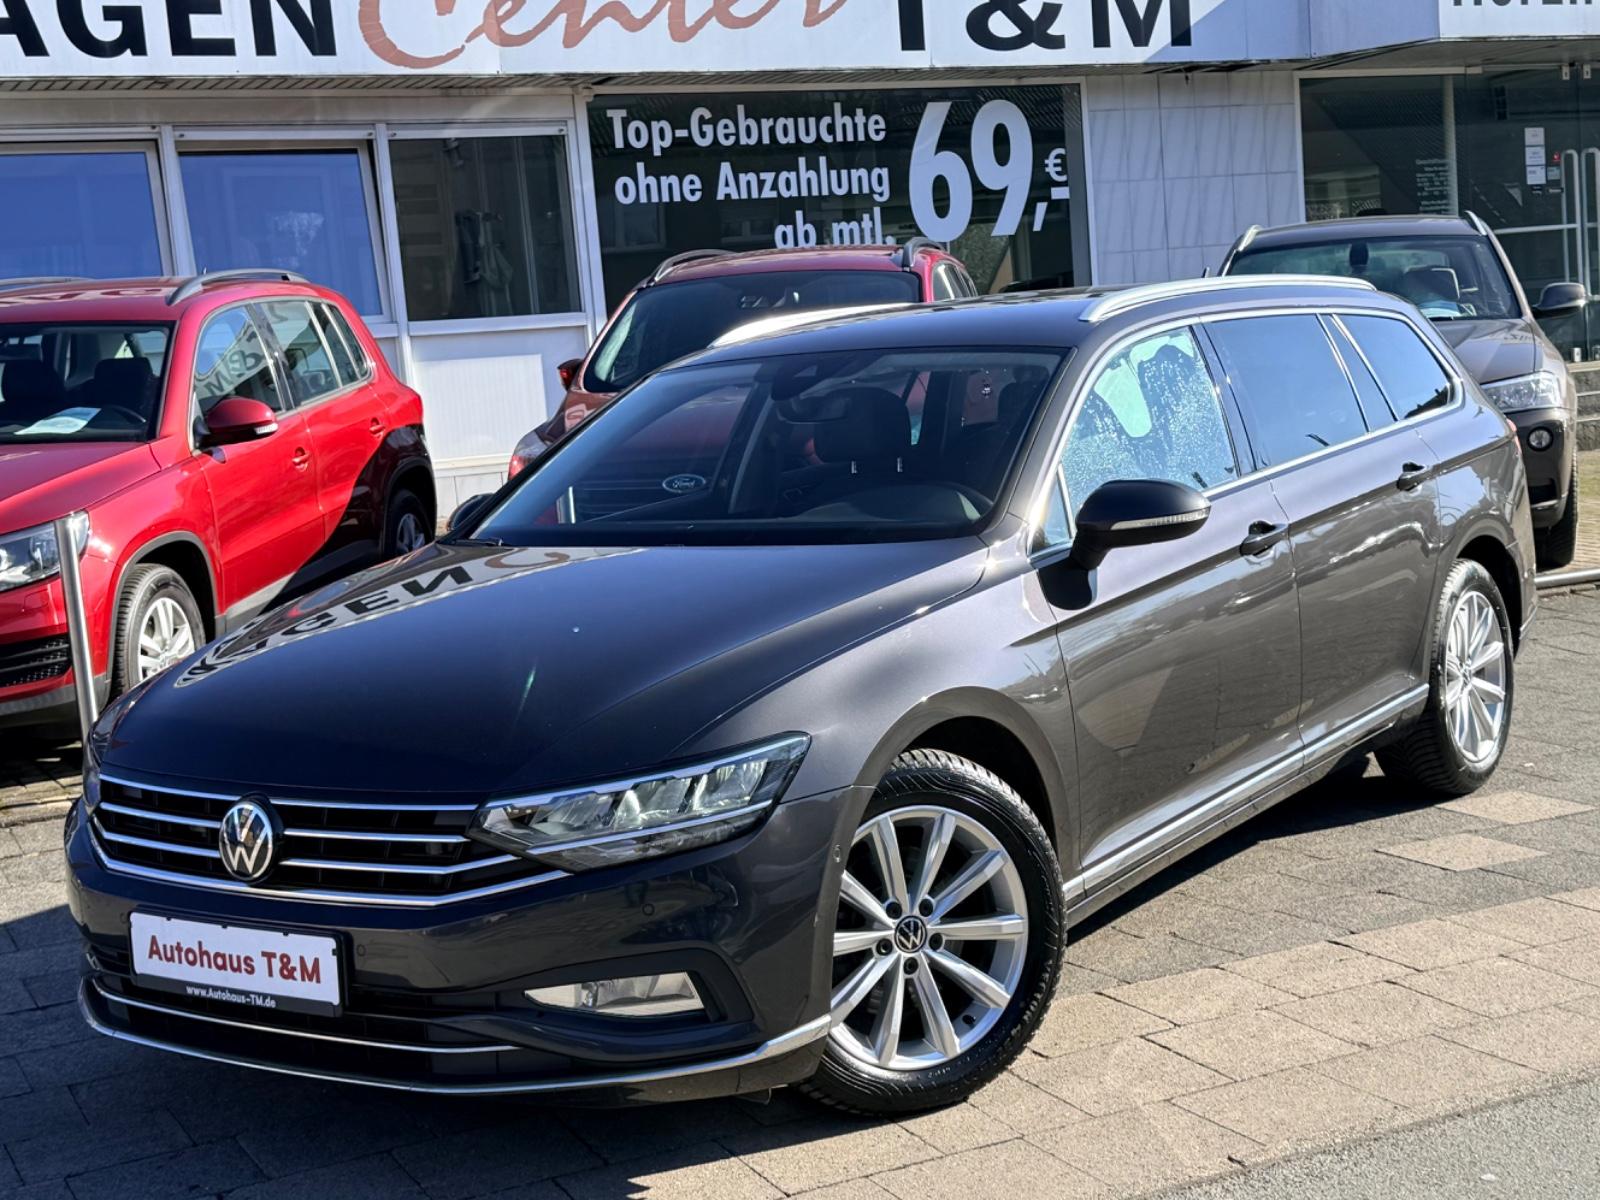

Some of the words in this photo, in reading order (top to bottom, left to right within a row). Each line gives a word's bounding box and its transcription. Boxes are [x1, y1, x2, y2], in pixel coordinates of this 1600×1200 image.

[606, 102, 887, 157] Top-Gebrauchte
[614, 162, 703, 204] ohne
[716, 156, 890, 202] Anzahlung
[774, 209, 818, 249] ab
[831, 206, 897, 247] mtl.
[148, 934, 256, 976] Autohaus
[261, 950, 322, 984] T&M
[185, 984, 277, 1009] www.Autohaus-TM.de
